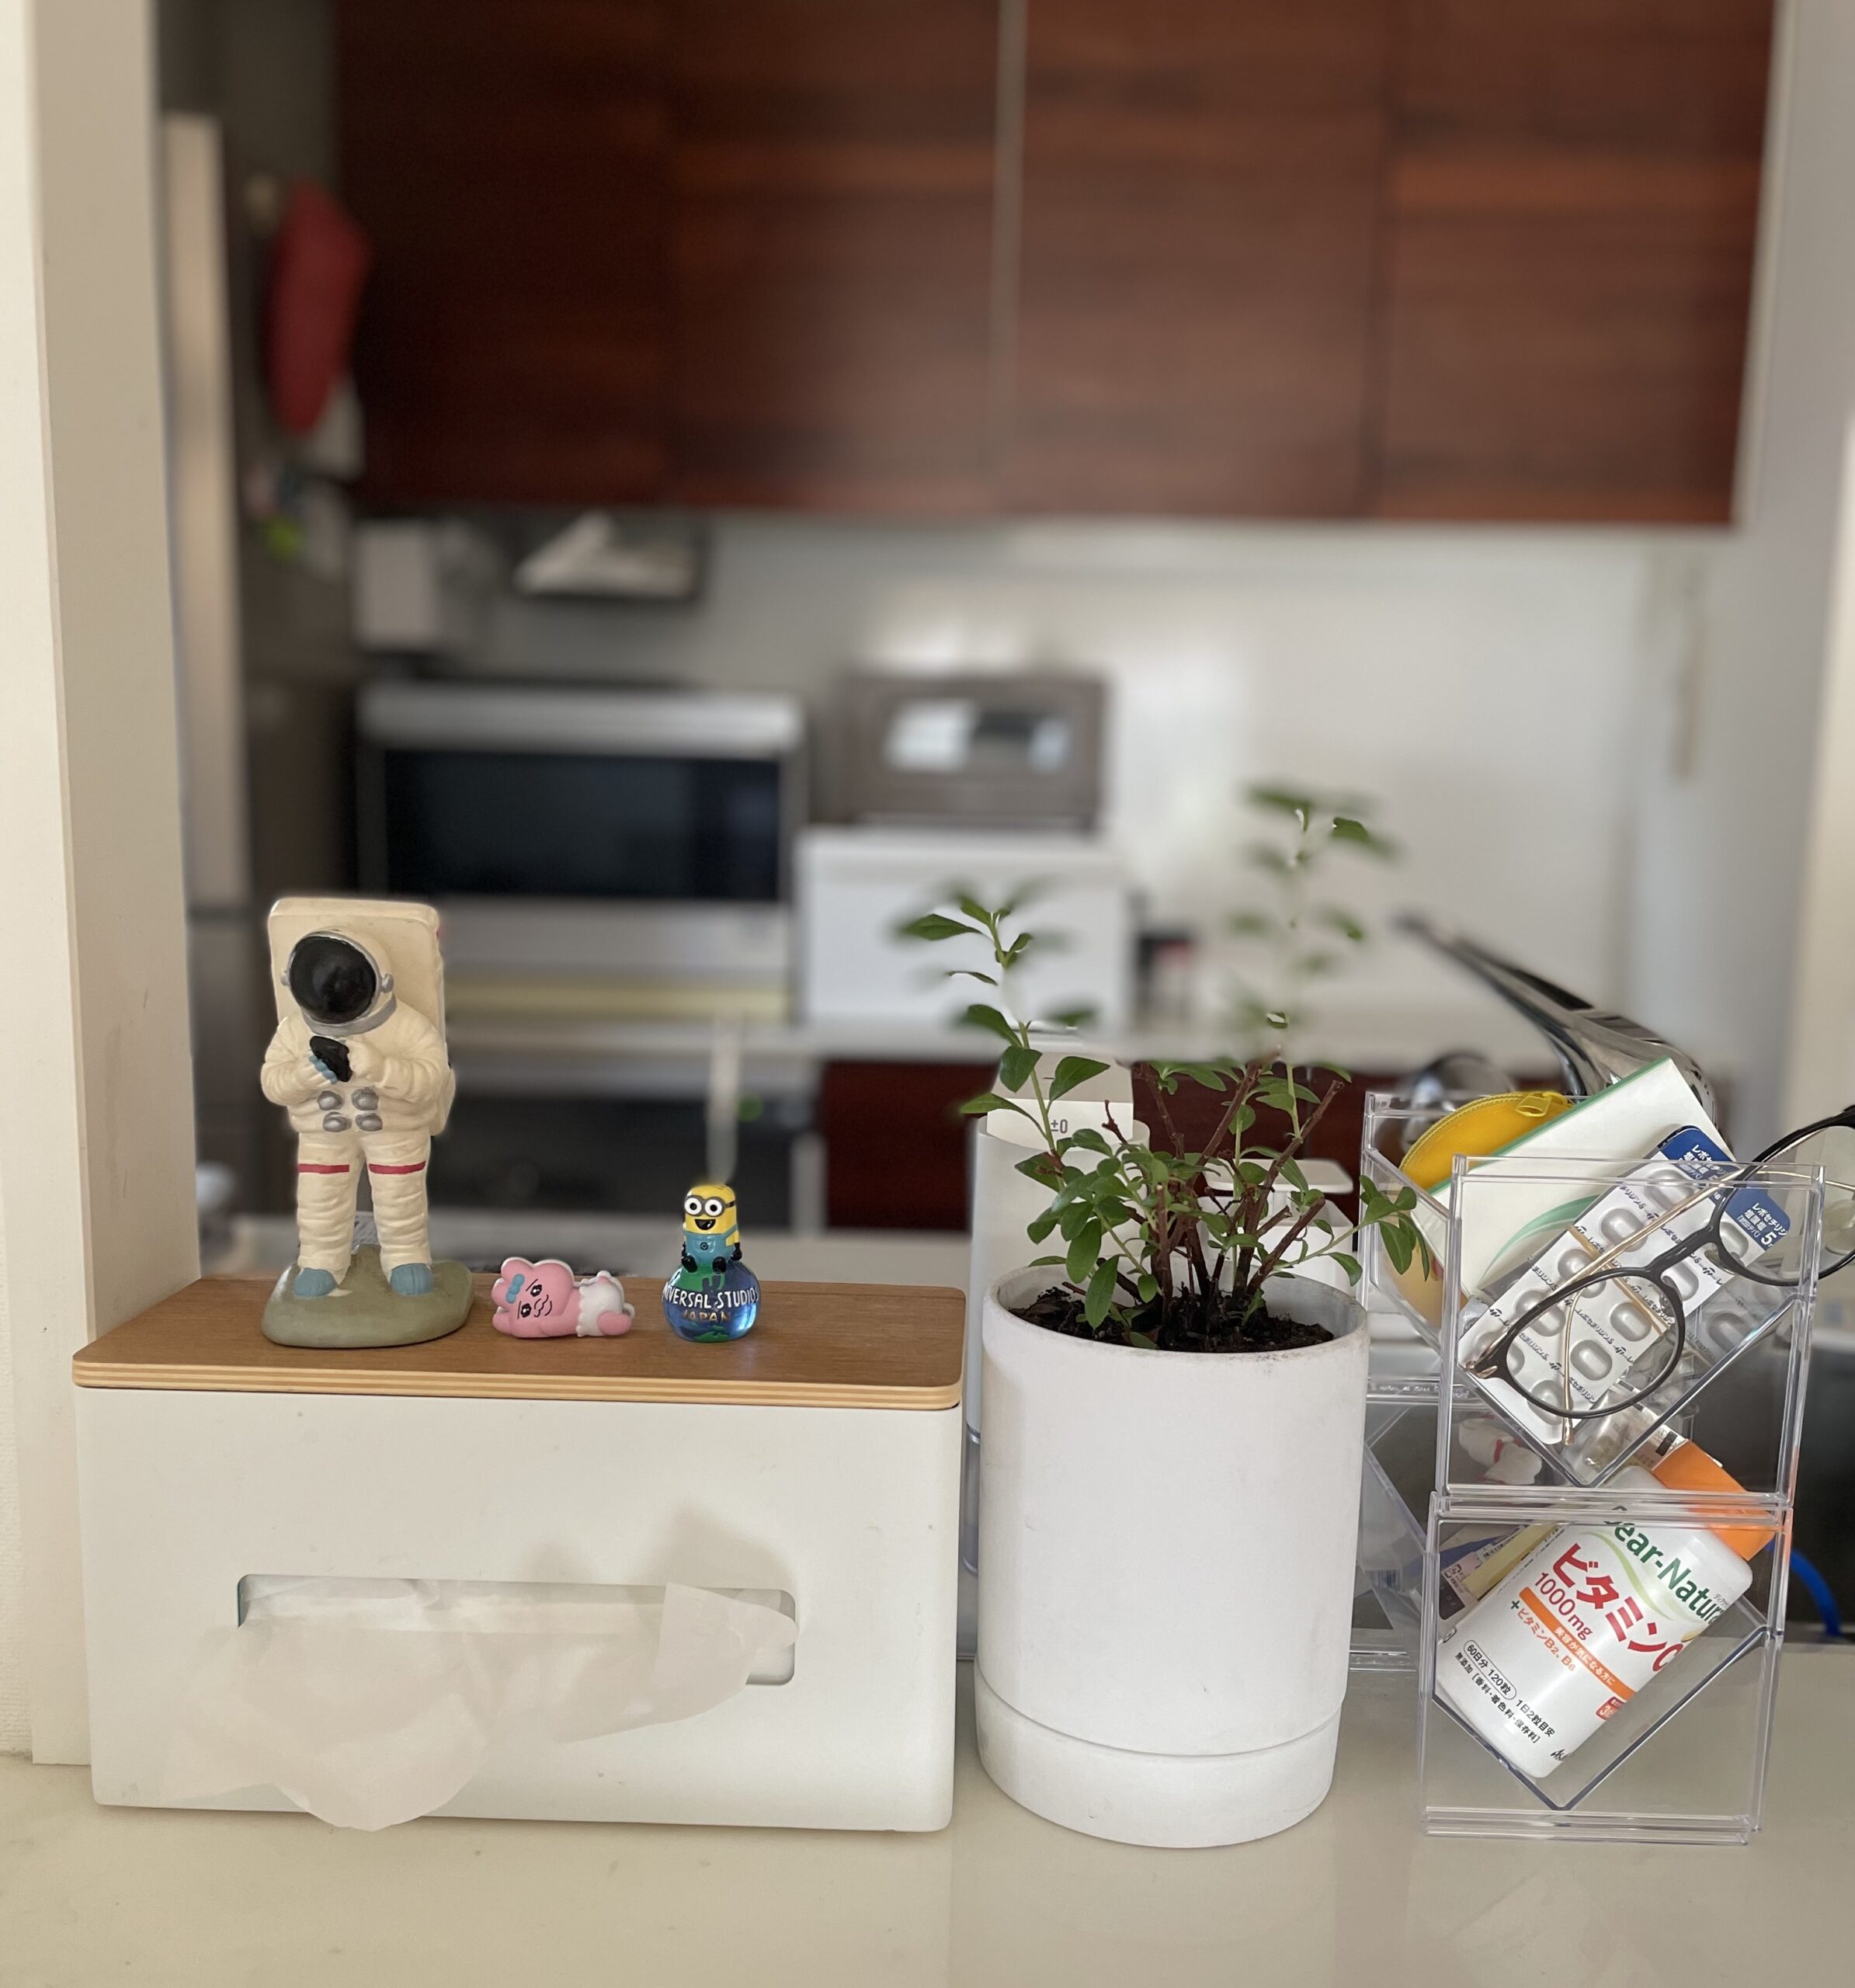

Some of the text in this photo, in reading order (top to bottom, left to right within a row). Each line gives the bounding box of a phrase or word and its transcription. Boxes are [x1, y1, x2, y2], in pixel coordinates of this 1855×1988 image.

[717, 1288, 759, 1309] STUDIOS
[1553, 1542, 1684, 1672] ビタミンC
[1603, 1505, 1725, 1625] ear-Natur
